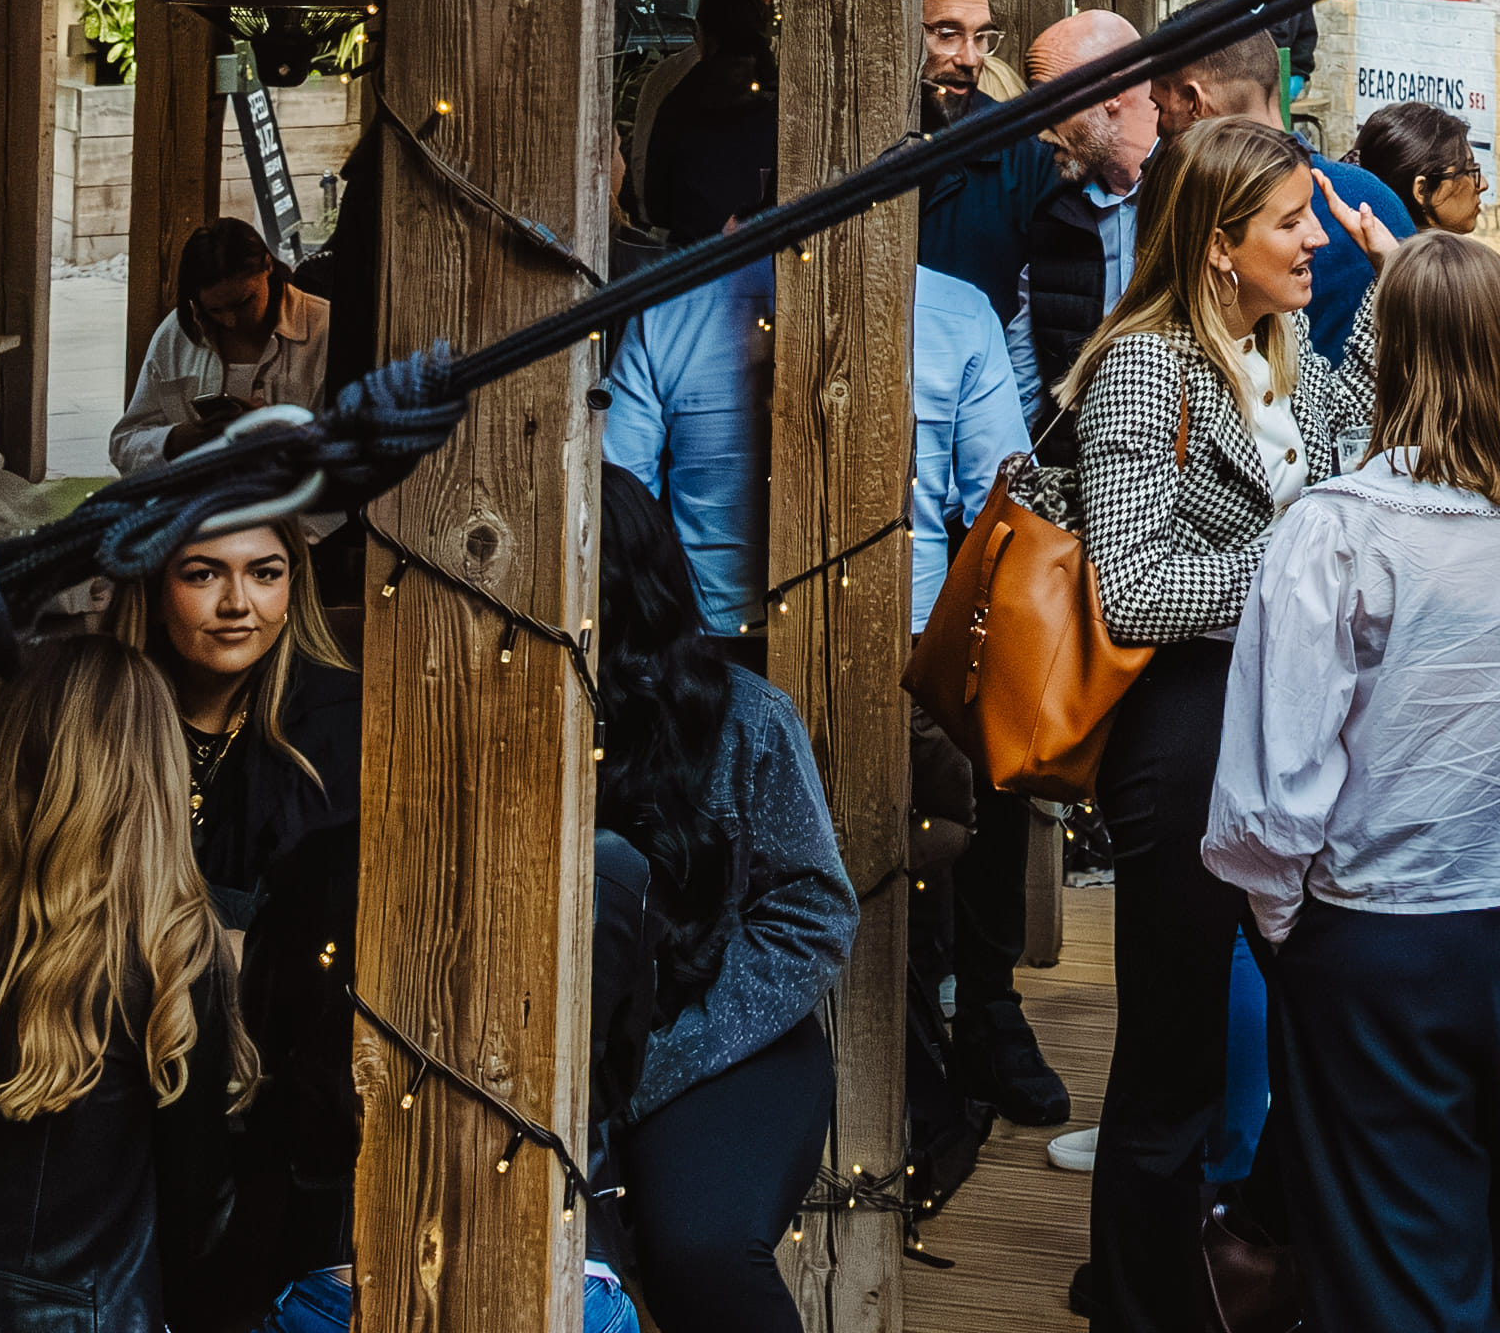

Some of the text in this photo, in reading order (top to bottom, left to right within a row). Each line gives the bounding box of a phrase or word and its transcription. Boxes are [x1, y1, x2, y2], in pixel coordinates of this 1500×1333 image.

[1358, 66, 1486, 110] BEAR GARDENS SE1
